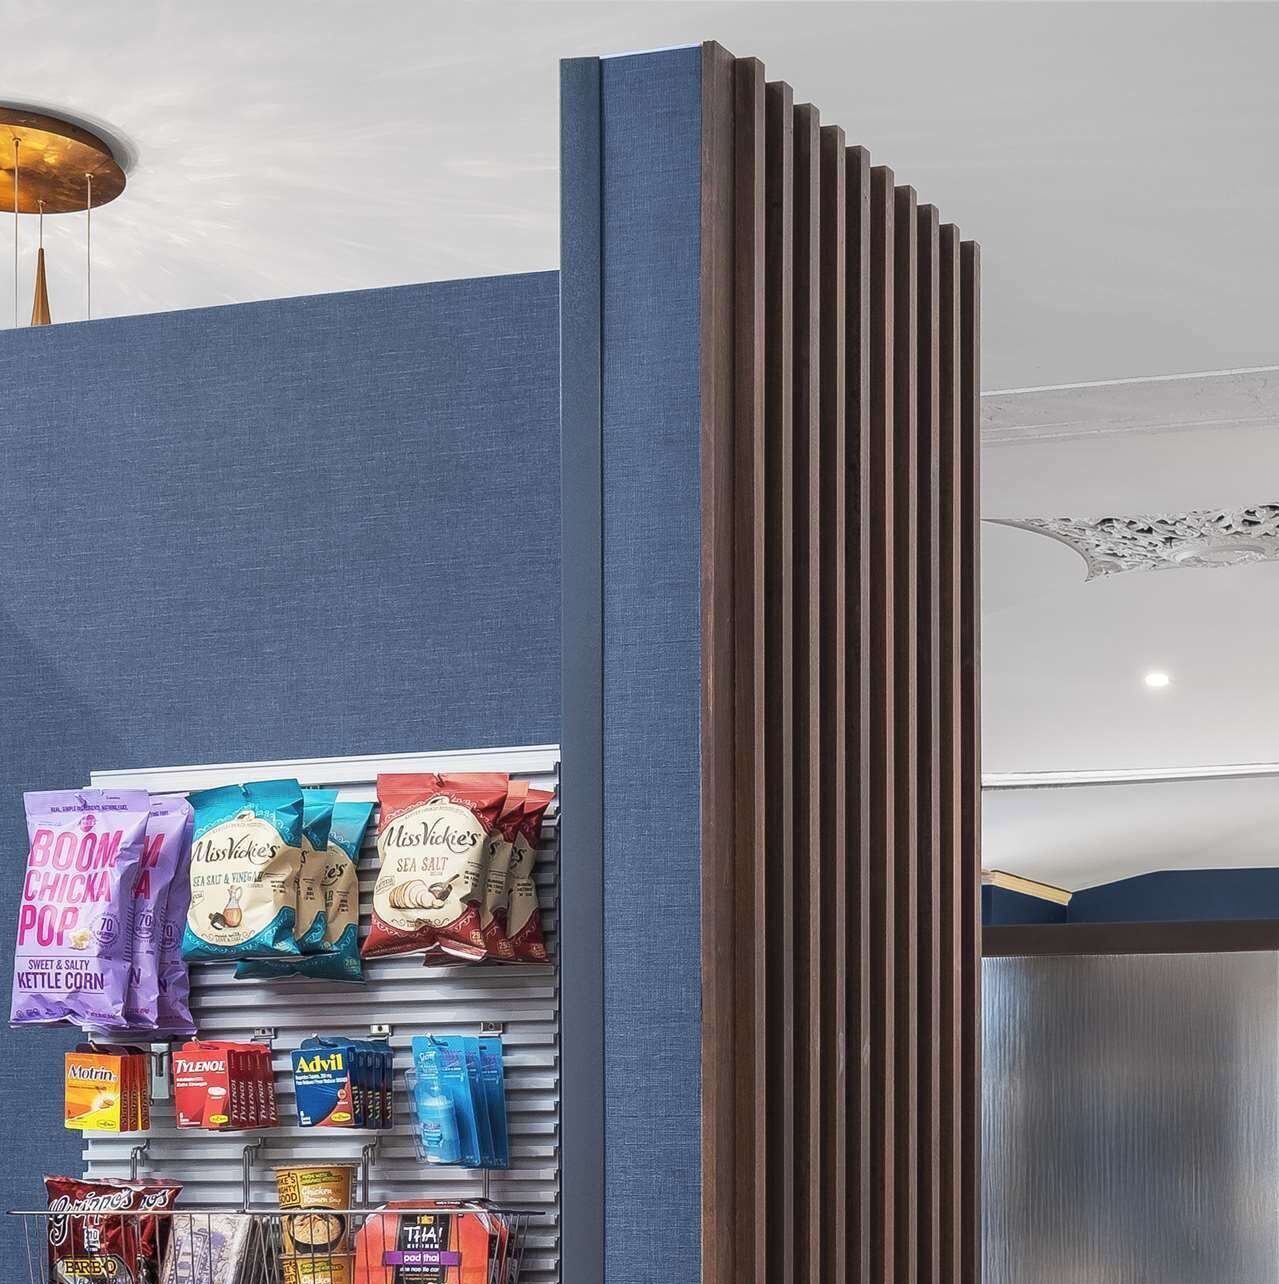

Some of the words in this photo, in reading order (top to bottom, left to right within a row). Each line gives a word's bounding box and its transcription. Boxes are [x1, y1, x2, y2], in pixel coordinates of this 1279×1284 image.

[29, 829, 123, 872] BOOM
[397, 858, 417, 872] SEA
[421, 857, 448, 872] SALT
[24, 870, 112, 903] CHICKA
[193, 875, 205, 887] SEA
[206, 873, 221, 886] SALT
[18, 904, 78, 947] POP
[100, 917, 113, 932] 70
[28, 959, 54, 970] SWEET
[56, 960, 62, 970] &
[64, 960, 90, 971] SALTY
[17, 972, 62, 989] KETTLE
[65, 972, 105, 990] CORN
[176, 1060, 225, 1074] TYLENOL
[296, 1053, 343, 1073] Advil
[68, 1064, 113, 1081] Motrin
[403, 1254, 422, 1264] pad
